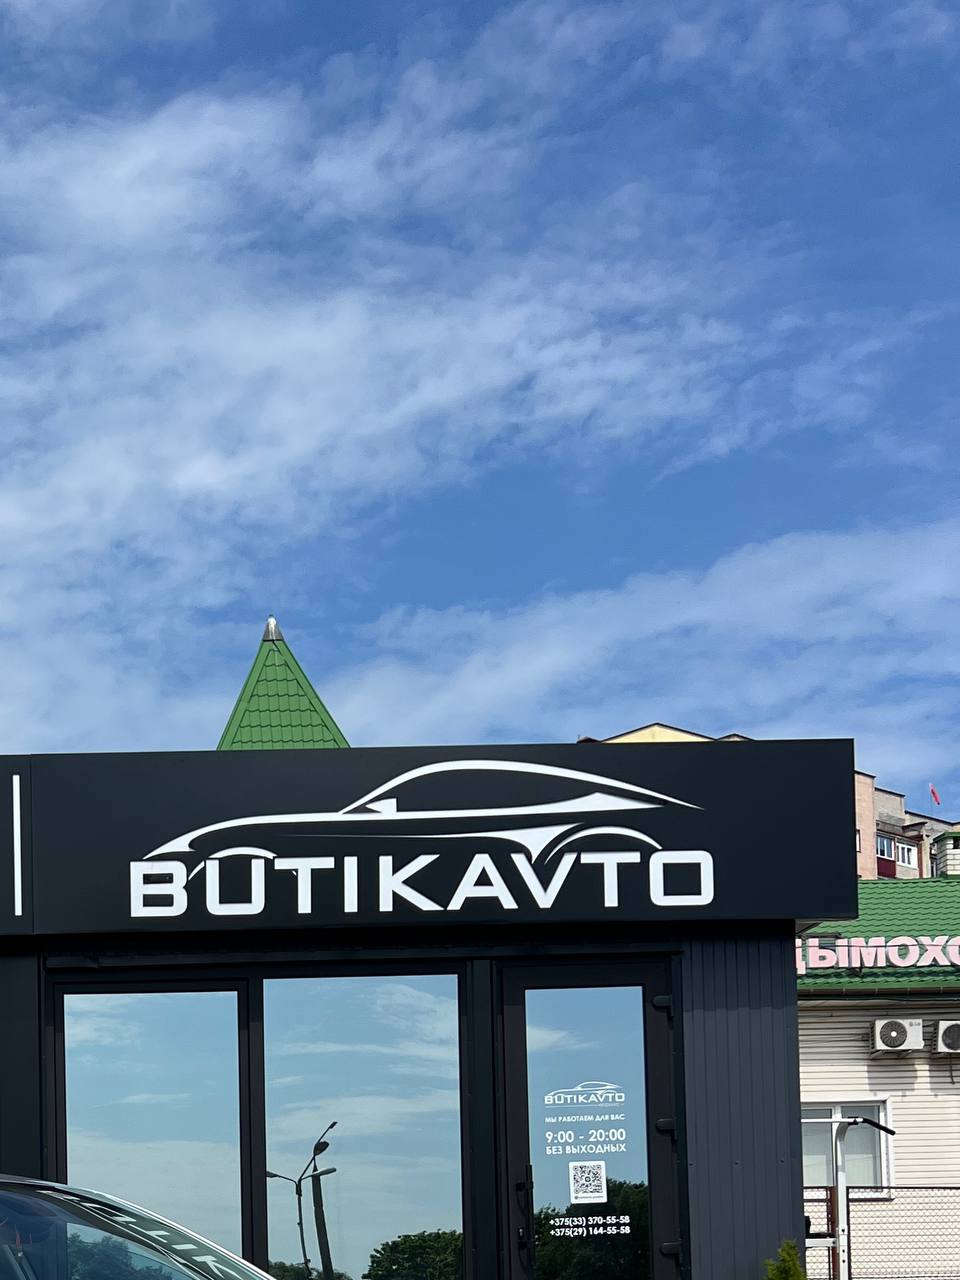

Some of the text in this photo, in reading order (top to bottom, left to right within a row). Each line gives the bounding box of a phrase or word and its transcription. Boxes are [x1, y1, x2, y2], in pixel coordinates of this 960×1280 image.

[129, 849, 715, 918] BUTIKAVTO
[544, 1093, 625, 1104] BUTIKAVTO
[595, 1114, 609, 1122] ДЛЯ
[545, 1130, 575, 1143] 9:00
[588, 1128, 626, 1142] 20:00
[545, 1143, 627, 1155] БЕЗ ВЫХОДНЫХ
[549, 1215, 630, 1227] +375(33) 370-55-58
[549, 1226, 631, 1237] +375(29) 164-55-58
